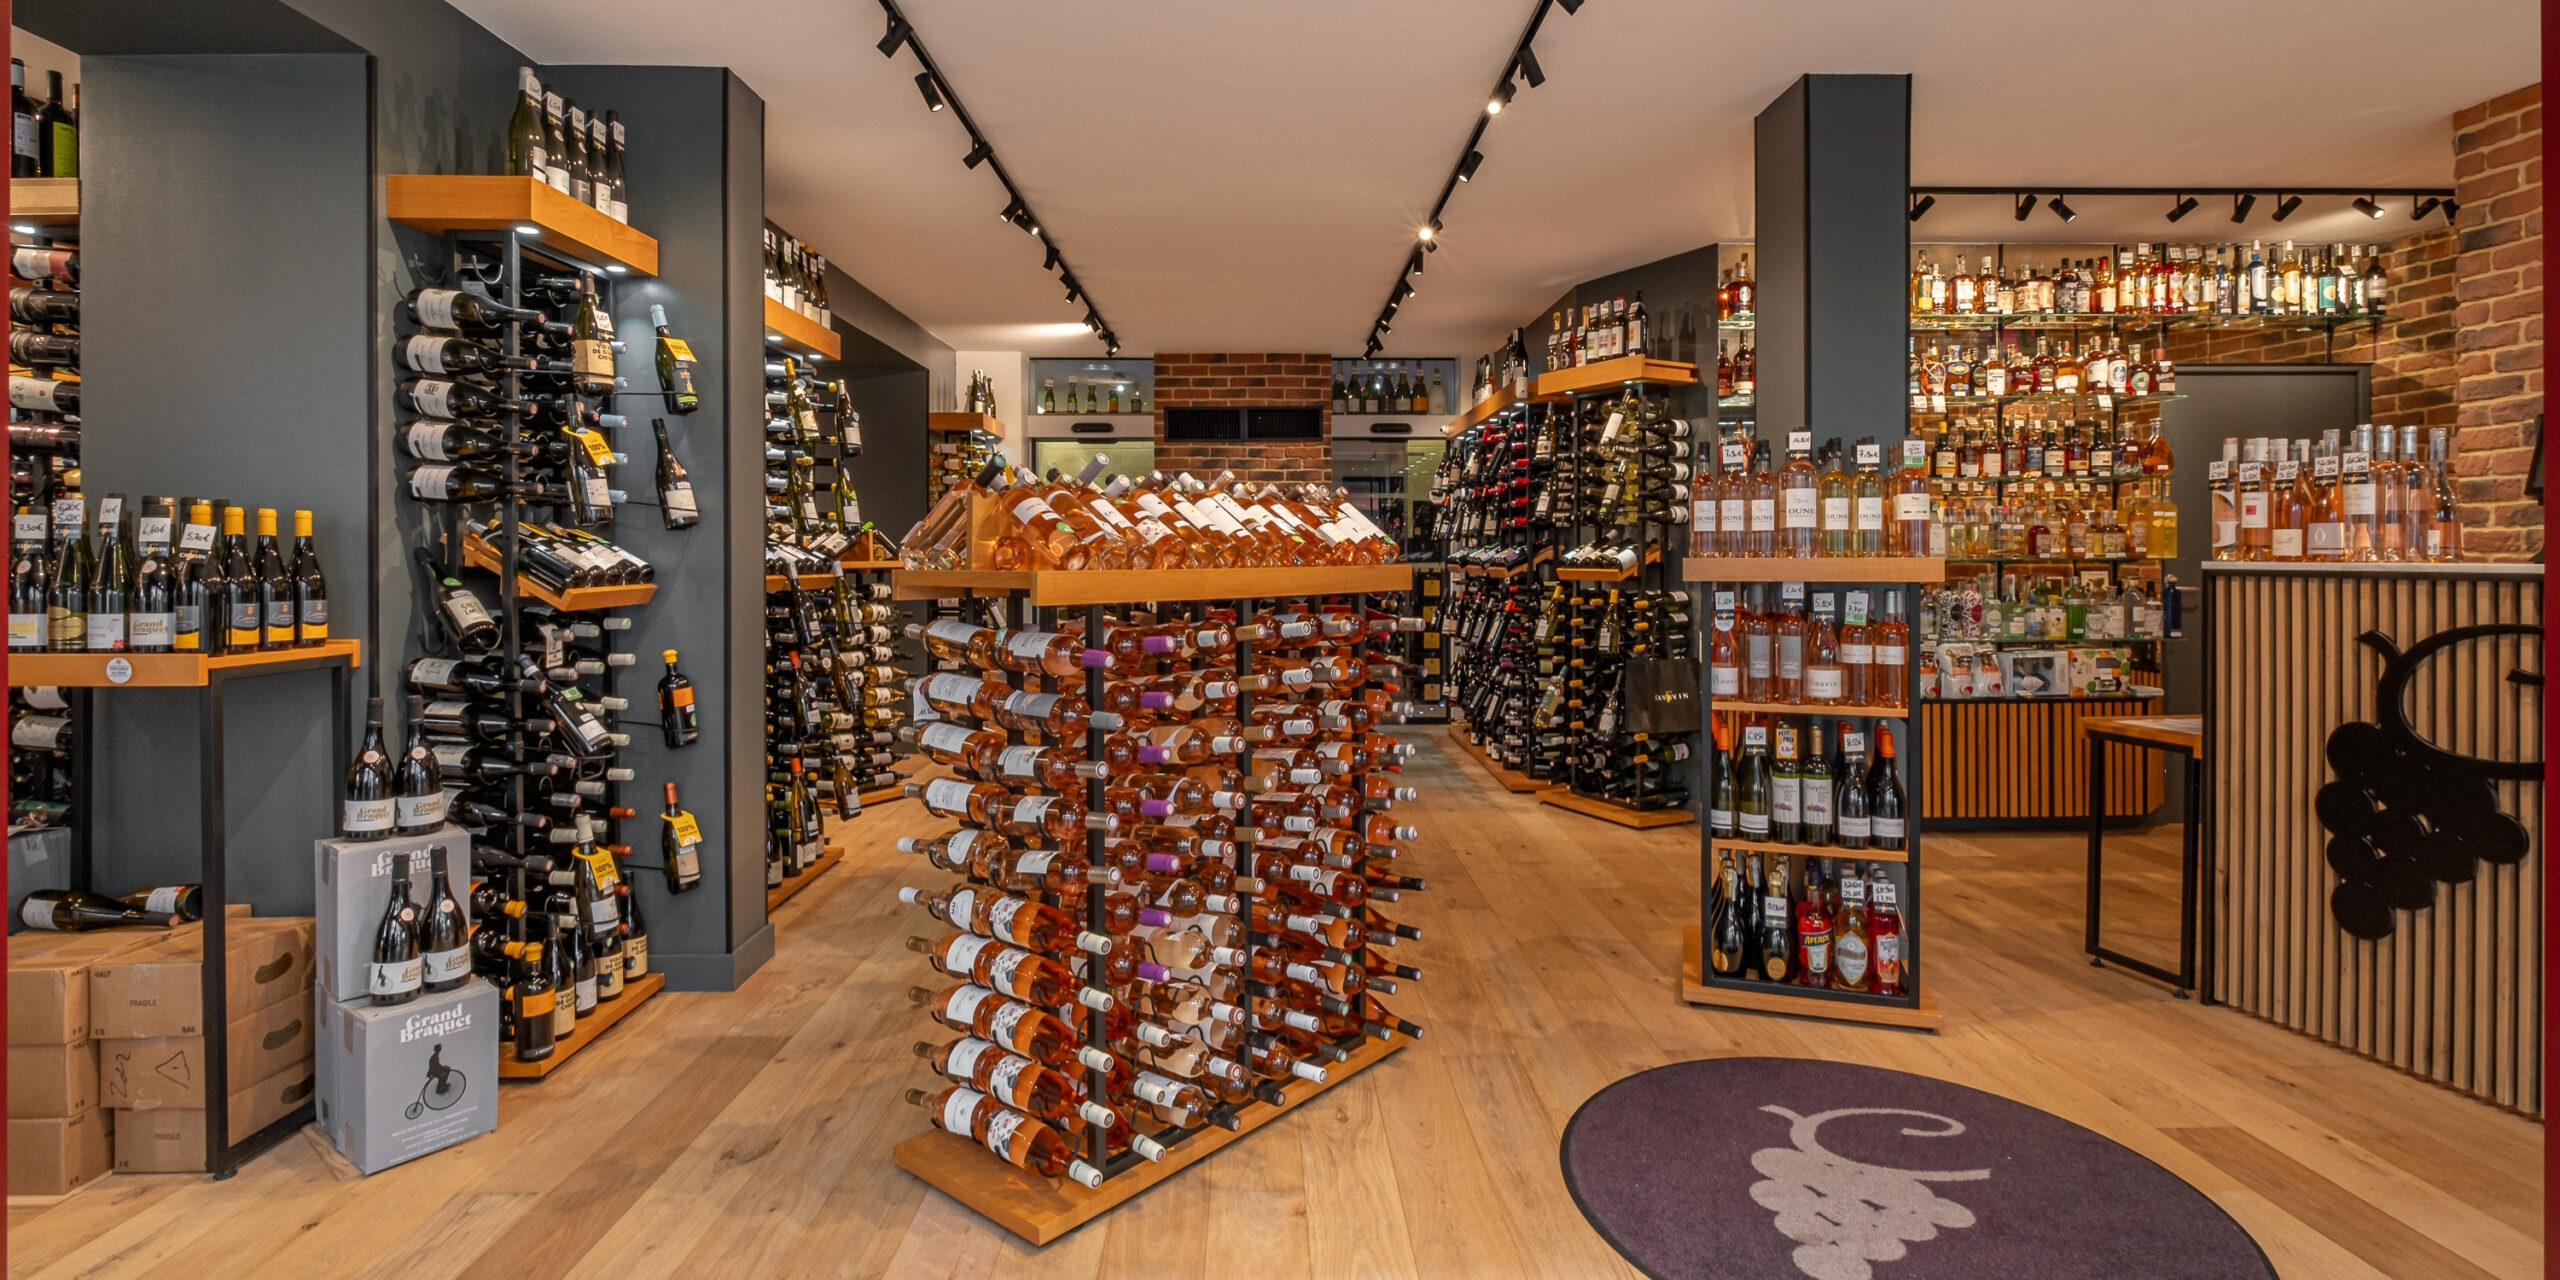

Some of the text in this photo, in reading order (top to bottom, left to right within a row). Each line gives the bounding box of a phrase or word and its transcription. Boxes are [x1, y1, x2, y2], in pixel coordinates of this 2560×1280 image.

[180, 552, 206, 560] CAVIN
[1655, 690, 1688, 702] CAVVIN
[678, 824, 695, 834] 100%
[377, 843, 434, 868] Gnd
[595, 862, 613, 873] 100%
[1805, 934, 1830, 945] APEROL
[95, 970, 112, 978] HAUT
[129, 999, 157, 1007] FRAGILE
[406, 1003, 463, 1031] Grand
[400, 1013, 472, 1044] Braquet
